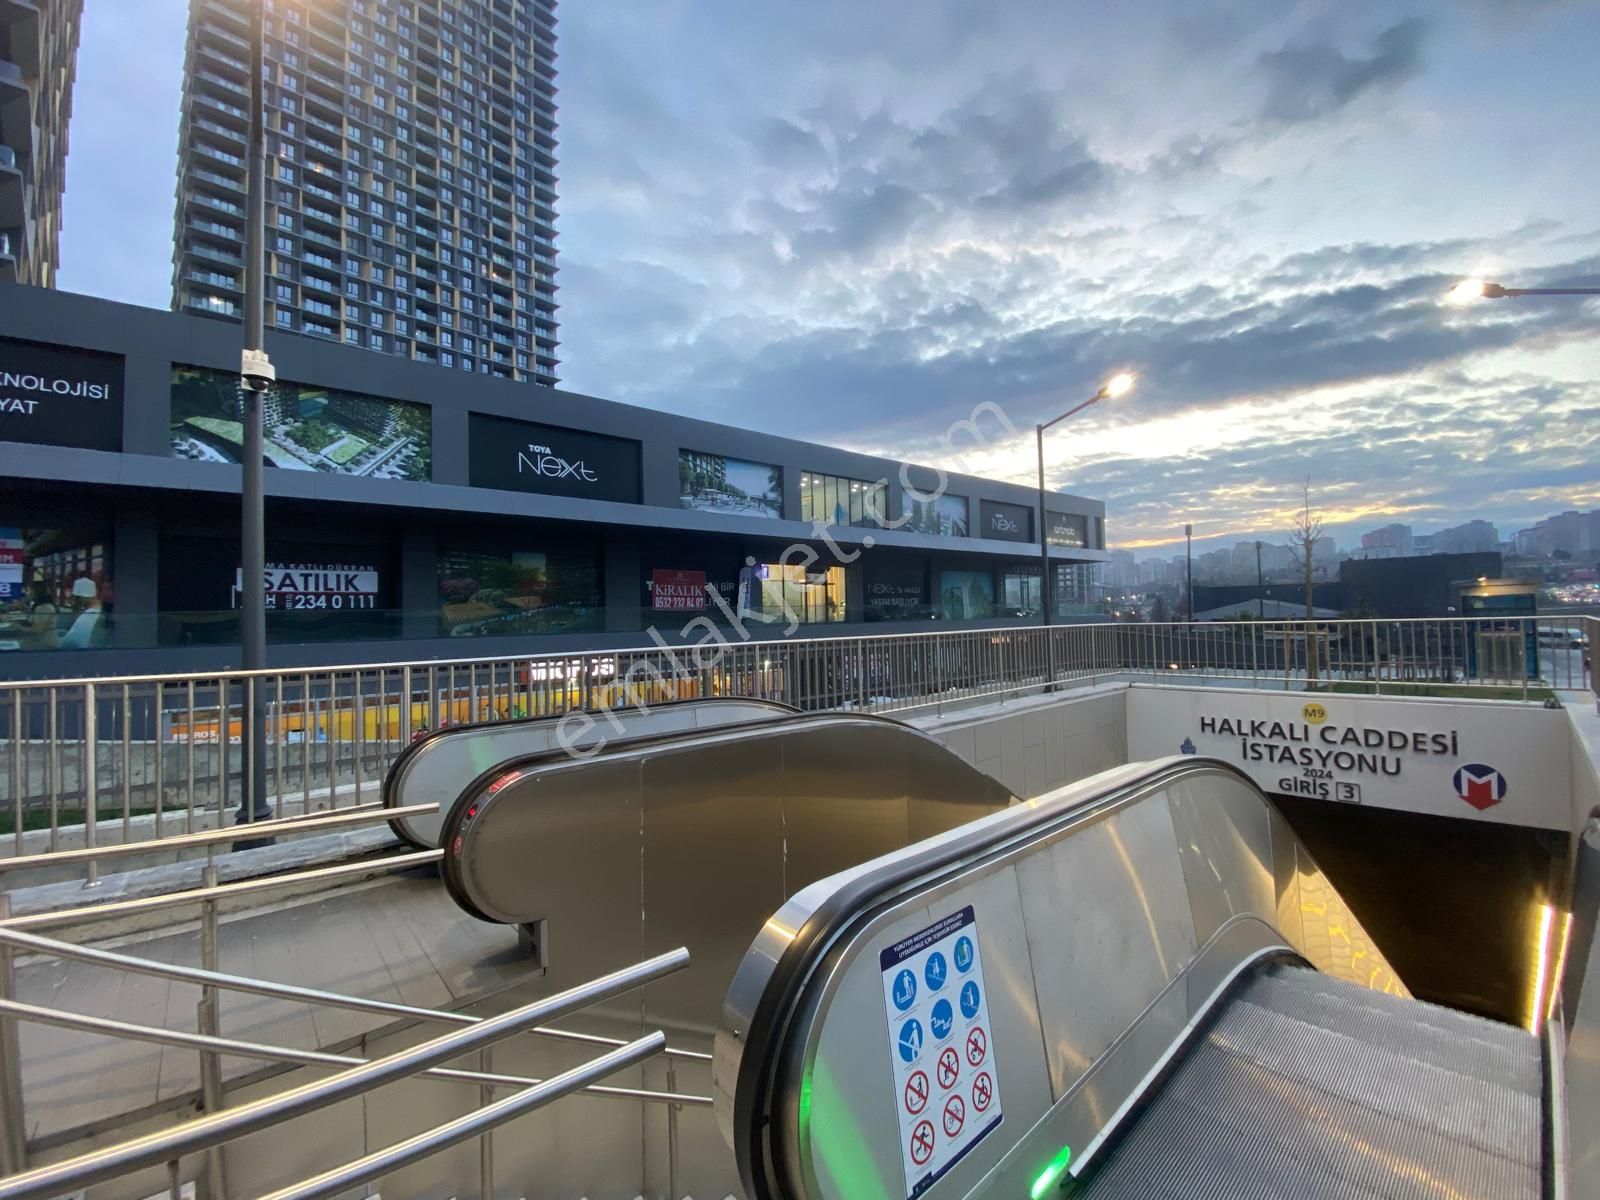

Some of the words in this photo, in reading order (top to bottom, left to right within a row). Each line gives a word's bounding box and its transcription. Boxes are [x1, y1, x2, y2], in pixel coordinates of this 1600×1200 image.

[528, 444, 552, 455] TOYA
[264, 571, 360, 592] SATILIK
[295, 594, 327, 609] 234
[331, 594, 342, 609] 0
[350, 594, 374, 609] 111
[1304, 707, 1325, 718] M9
[1200, 716, 1310, 743] HALKALI
[1319, 726, 1459, 756] CADDESİ
[1241, 738, 1402, 777] İSTASYONU
[1303, 768, 1333, 780] 2024
[1278, 776, 1330, 800] GİRİŞ
[1343, 785, 1355, 799] 3
